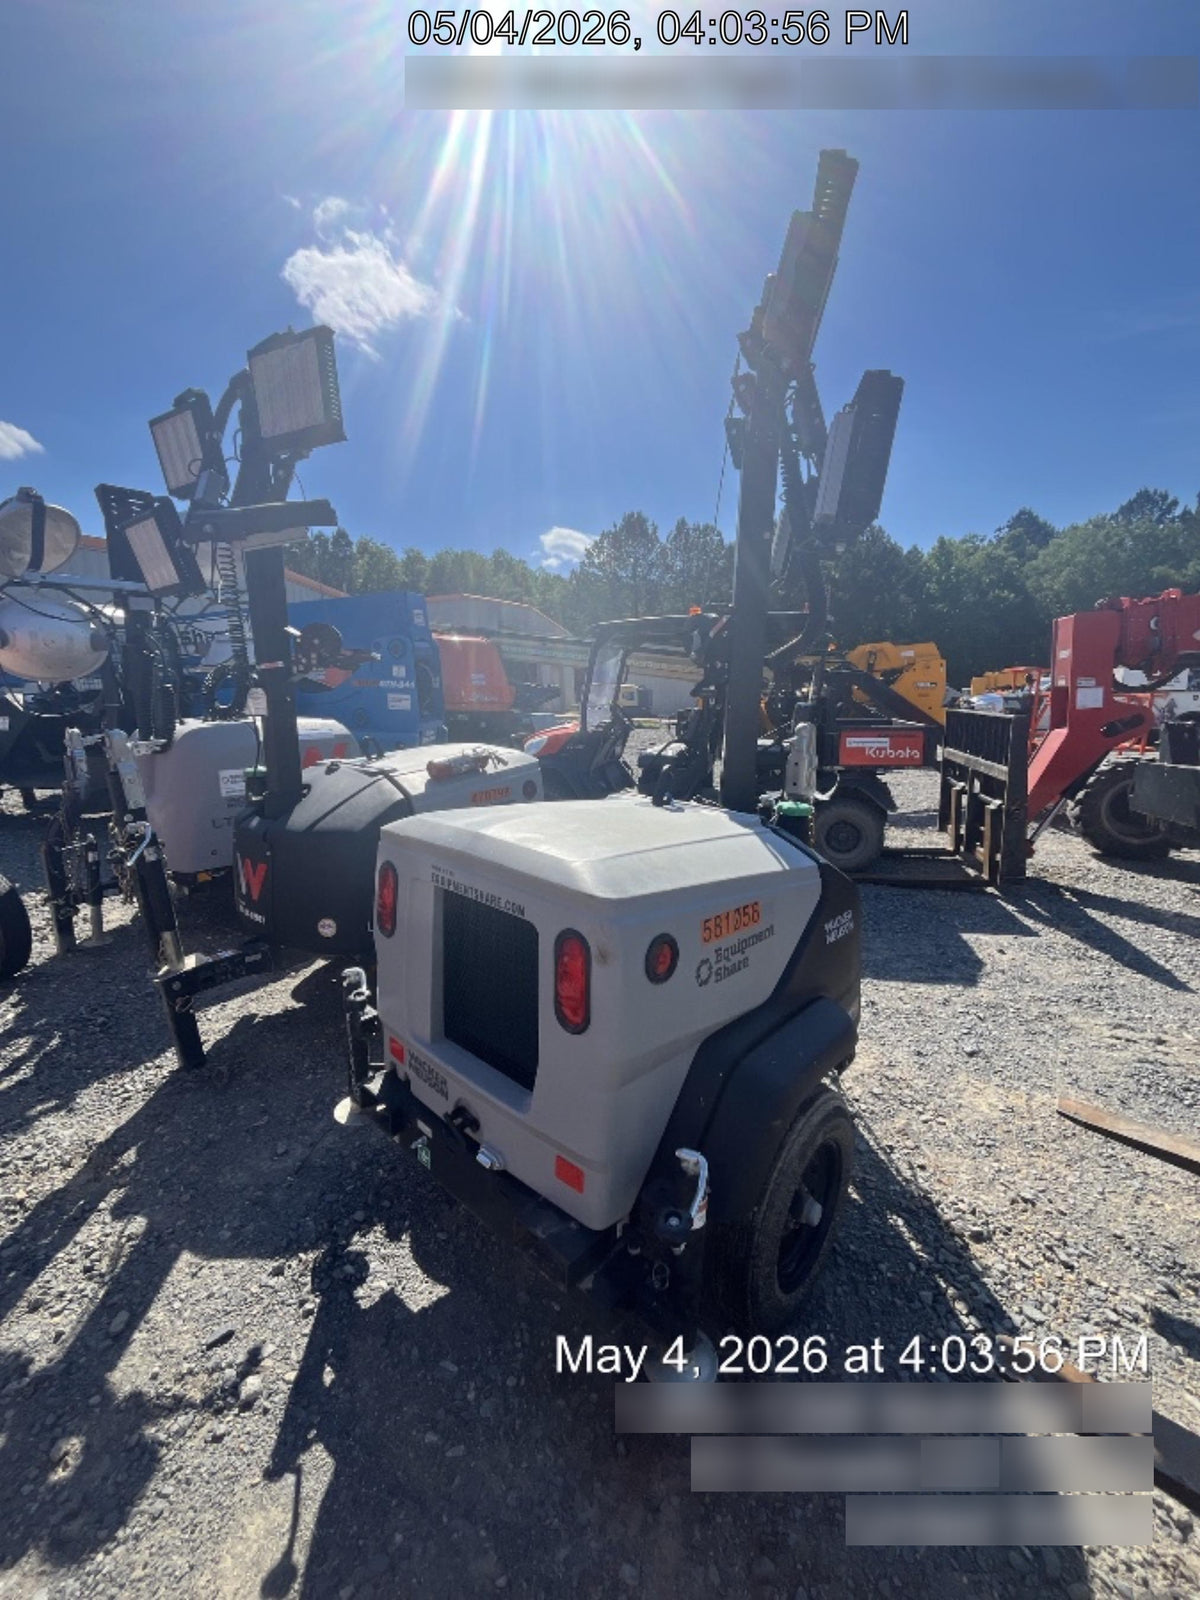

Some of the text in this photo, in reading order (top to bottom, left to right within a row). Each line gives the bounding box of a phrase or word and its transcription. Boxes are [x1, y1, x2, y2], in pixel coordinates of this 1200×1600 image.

[865, 746, 920, 758] Kubota
[714, 924, 775, 964] Equipment
[714, 956, 750, 984] Share
